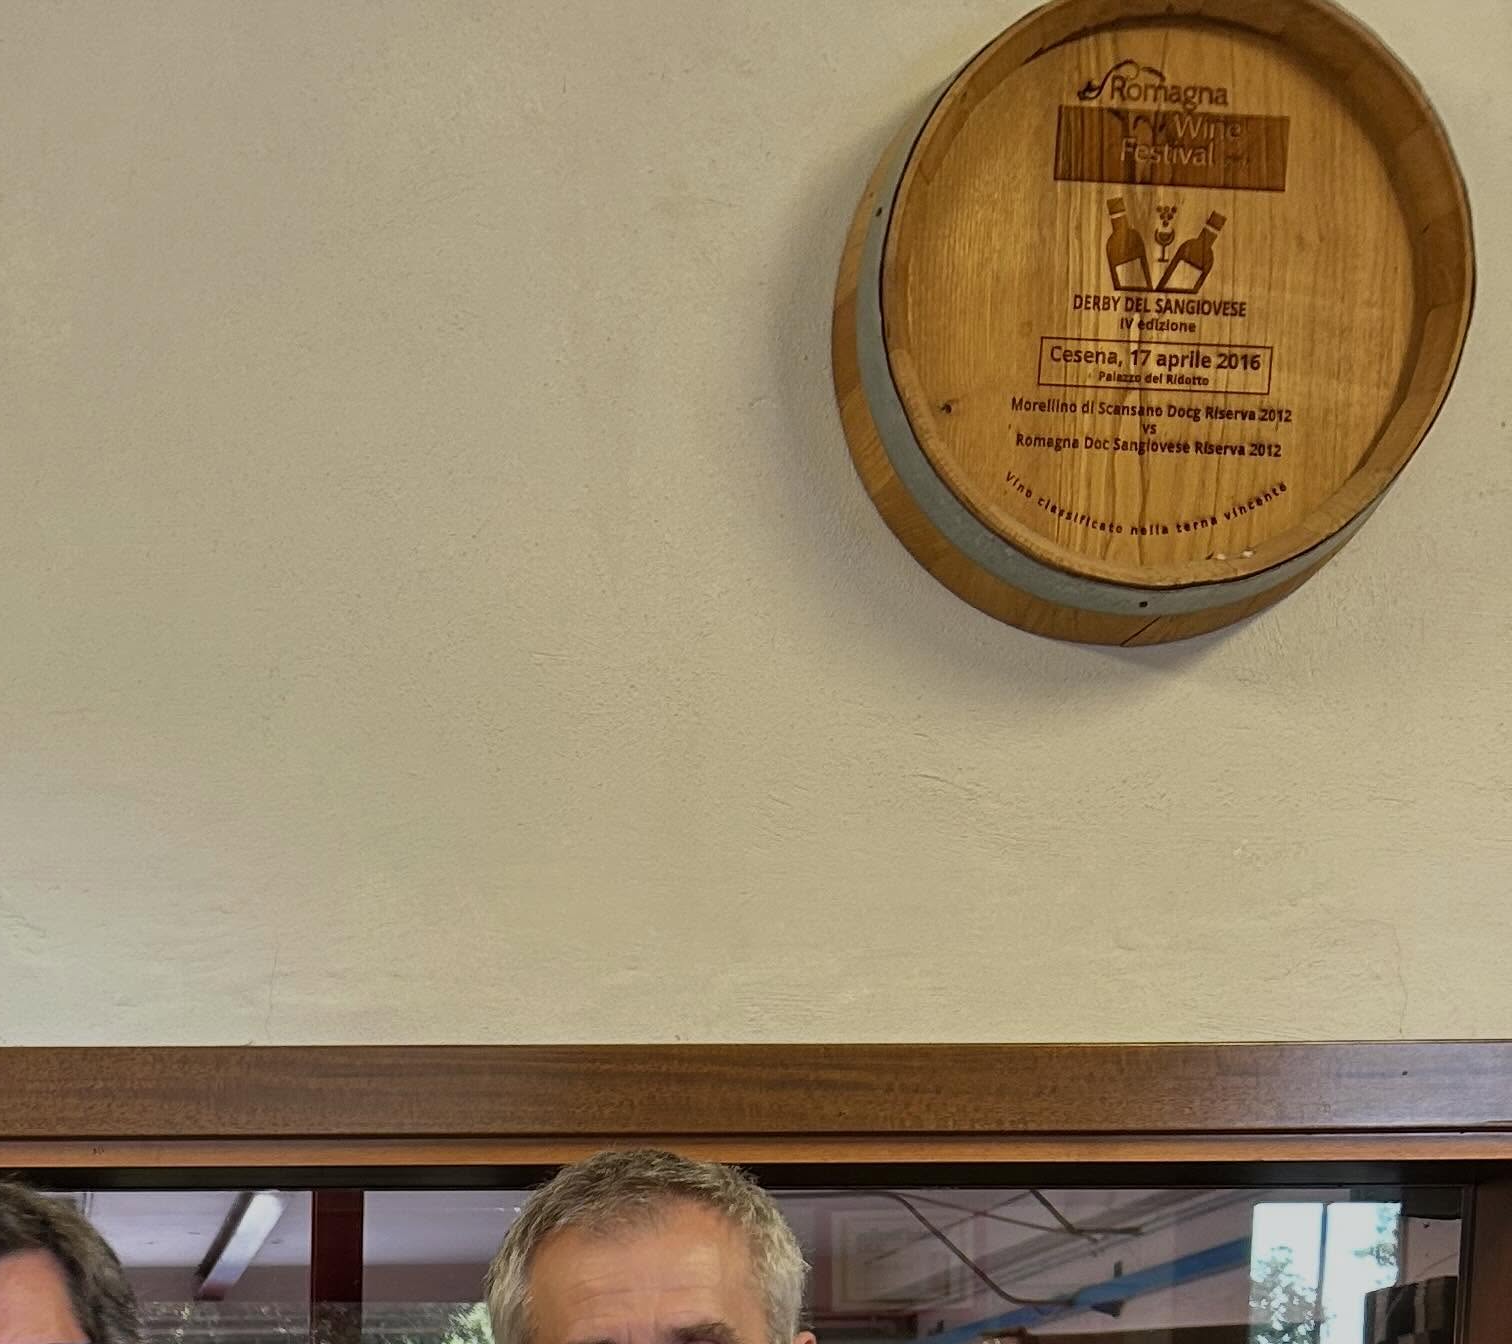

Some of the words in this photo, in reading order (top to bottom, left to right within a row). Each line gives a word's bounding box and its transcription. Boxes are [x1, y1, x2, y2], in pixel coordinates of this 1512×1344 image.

[1110, 74, 1229, 111] Romagna
[1174, 113, 1242, 141] Wine
[1120, 137, 1216, 166] Festival
[1073, 294, 1121, 312] DERBY
[1124, 296, 1152, 314] DEL
[1154, 297, 1247, 317] SANGIOVESE
[1120, 317, 1135, 330] IV
[1137, 318, 1197, 333] edizione
[1050, 345, 1123, 368] Cesena,
[1130, 349, 1152, 367] 17
[1156, 350, 1212, 372] aprile
[1216, 352, 1261, 371] 2016
[1098, 370, 1142, 384] Palazzo
[1144, 372, 1163, 385] del
[1166, 373, 1210, 387] Ridotto
[1011, 396, 1078, 414] Morellino
[1081, 399, 1094, 414] di
[1098, 401, 1163, 418] Scansano
[1167, 404, 1201, 422] Docg
[1205, 406, 1256, 421] Riserva
[1258, 407, 1293, 423] 2012
[1142, 422, 1158, 435] vs
[1016, 433, 1080, 452] Romagna
[1084, 436, 1110, 451] Doc
[1113, 437, 1191, 456] Sangiovese
[1194, 440, 1246, 456] Riserva
[1249, 443, 1282, 457] 2012
[1005, 470, 1034, 499] Vino
[1037, 497, 1124, 535] classificato
[1130, 523, 1169, 536] nella
[1176, 515, 1218, 534] terna
[1223, 480, 1288, 521] vincente
